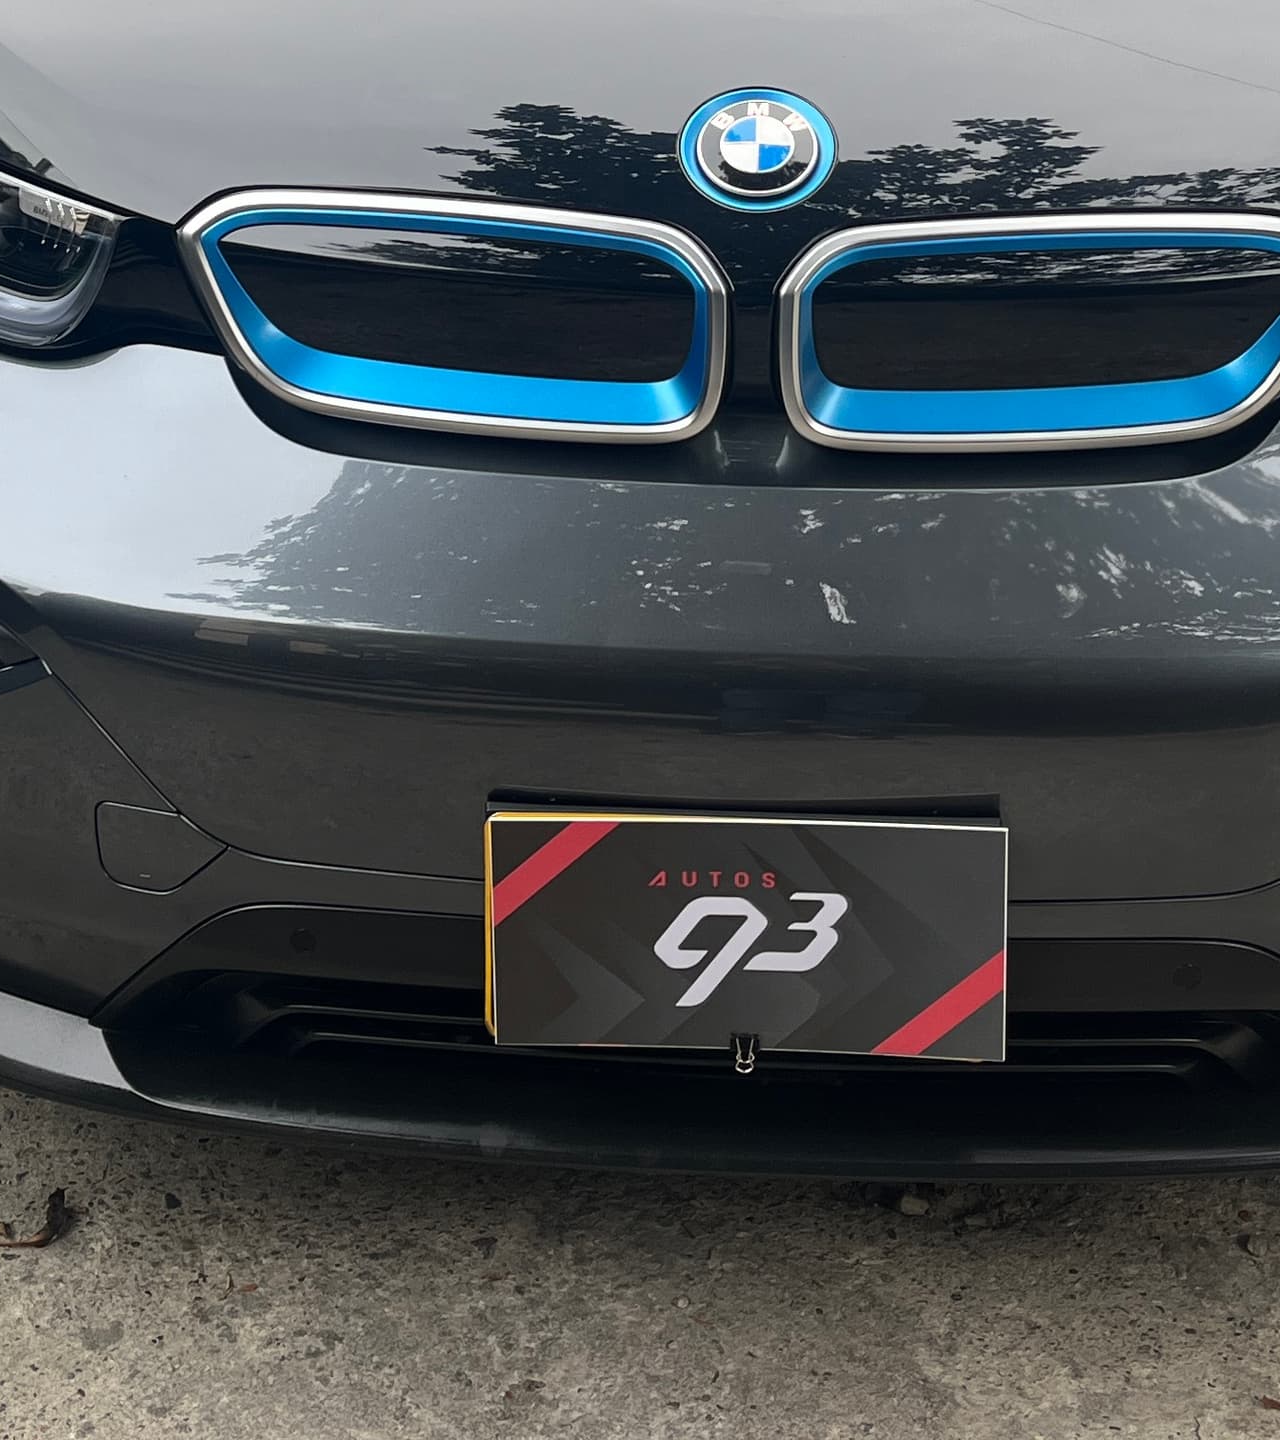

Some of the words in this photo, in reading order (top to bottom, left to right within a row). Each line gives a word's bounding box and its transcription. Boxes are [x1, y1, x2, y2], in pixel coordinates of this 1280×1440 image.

[709, 101, 809, 132] BMW
[647, 870, 776, 888] AUTOS
[653, 892, 848, 1007] 93
